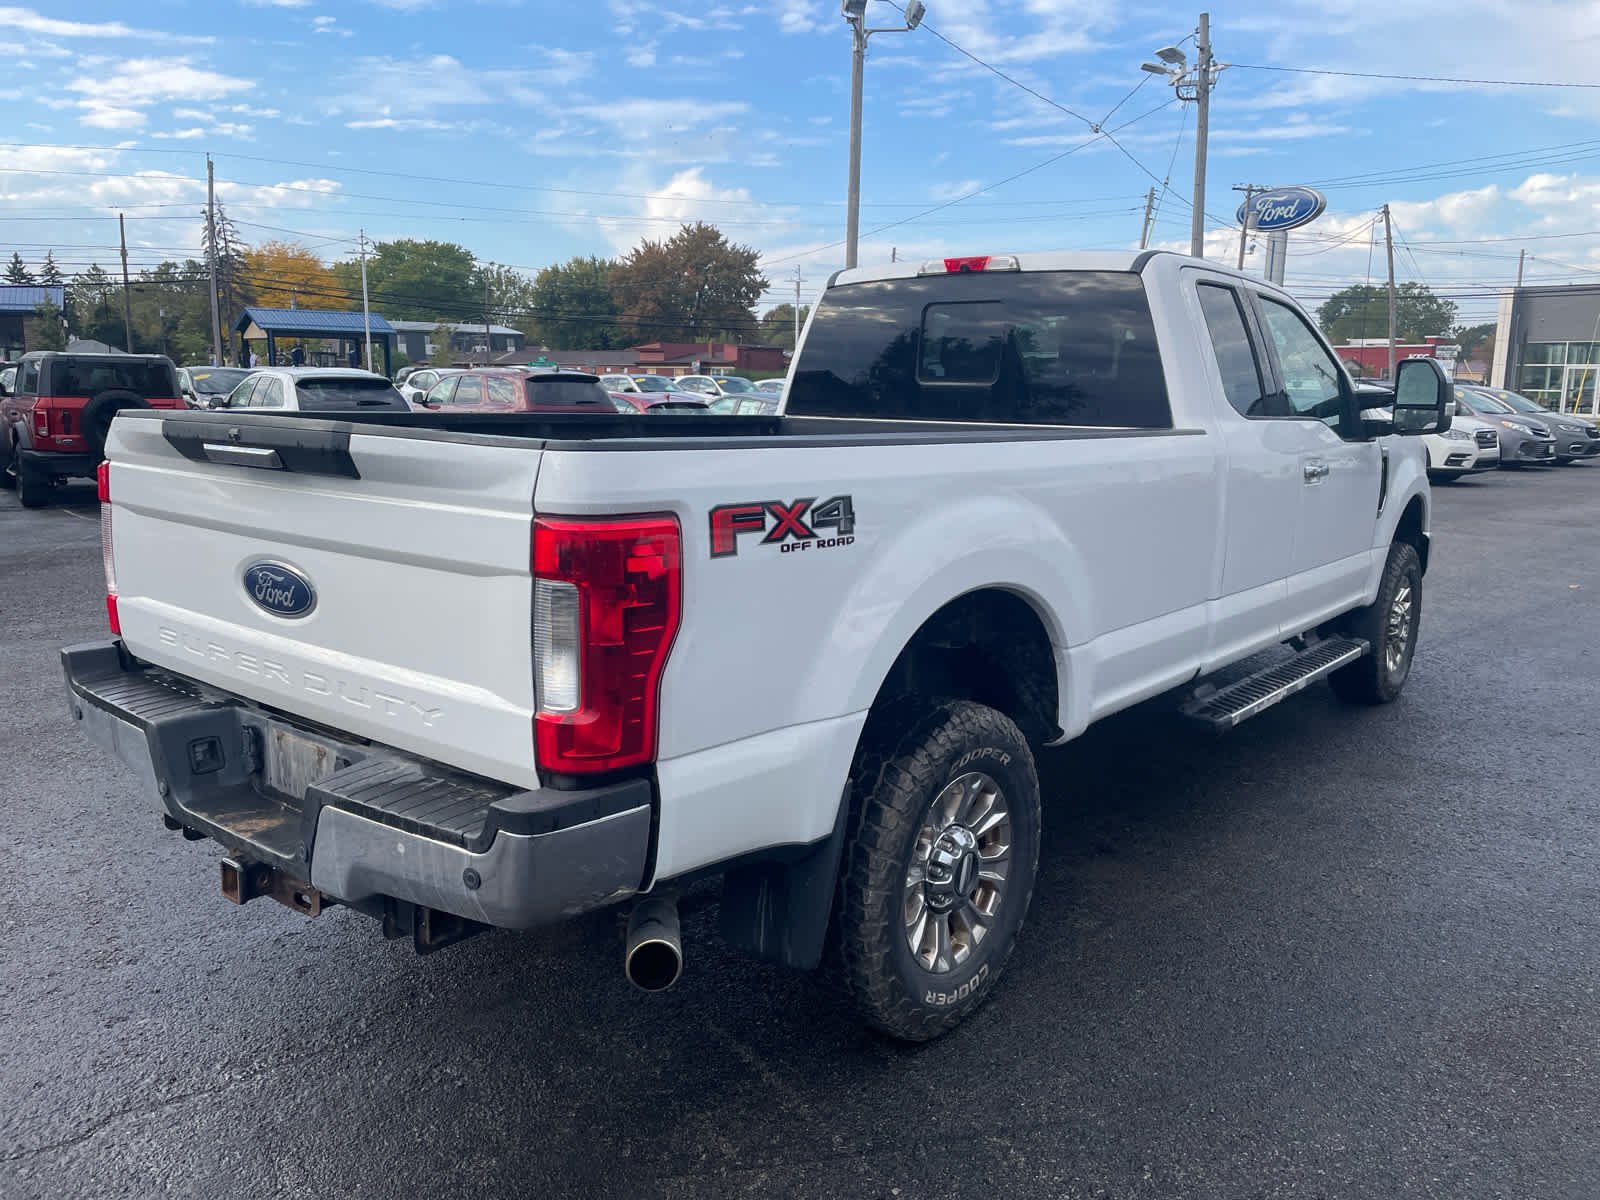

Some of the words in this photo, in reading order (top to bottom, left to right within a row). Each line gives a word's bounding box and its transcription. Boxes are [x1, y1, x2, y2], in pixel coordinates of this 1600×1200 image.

[1256, 195, 1301, 222] Ford
[709, 495, 855, 558] FX4
[781, 542, 811, 553] OFF
[817, 537, 855, 549] ROAD
[256, 570, 295, 608] Ford
[159, 626, 289, 684] SUPER
[304, 674, 444, 727] DUTY
[951, 747, 1012, 773] COOPER
[926, 963, 989, 1006] COOPER
